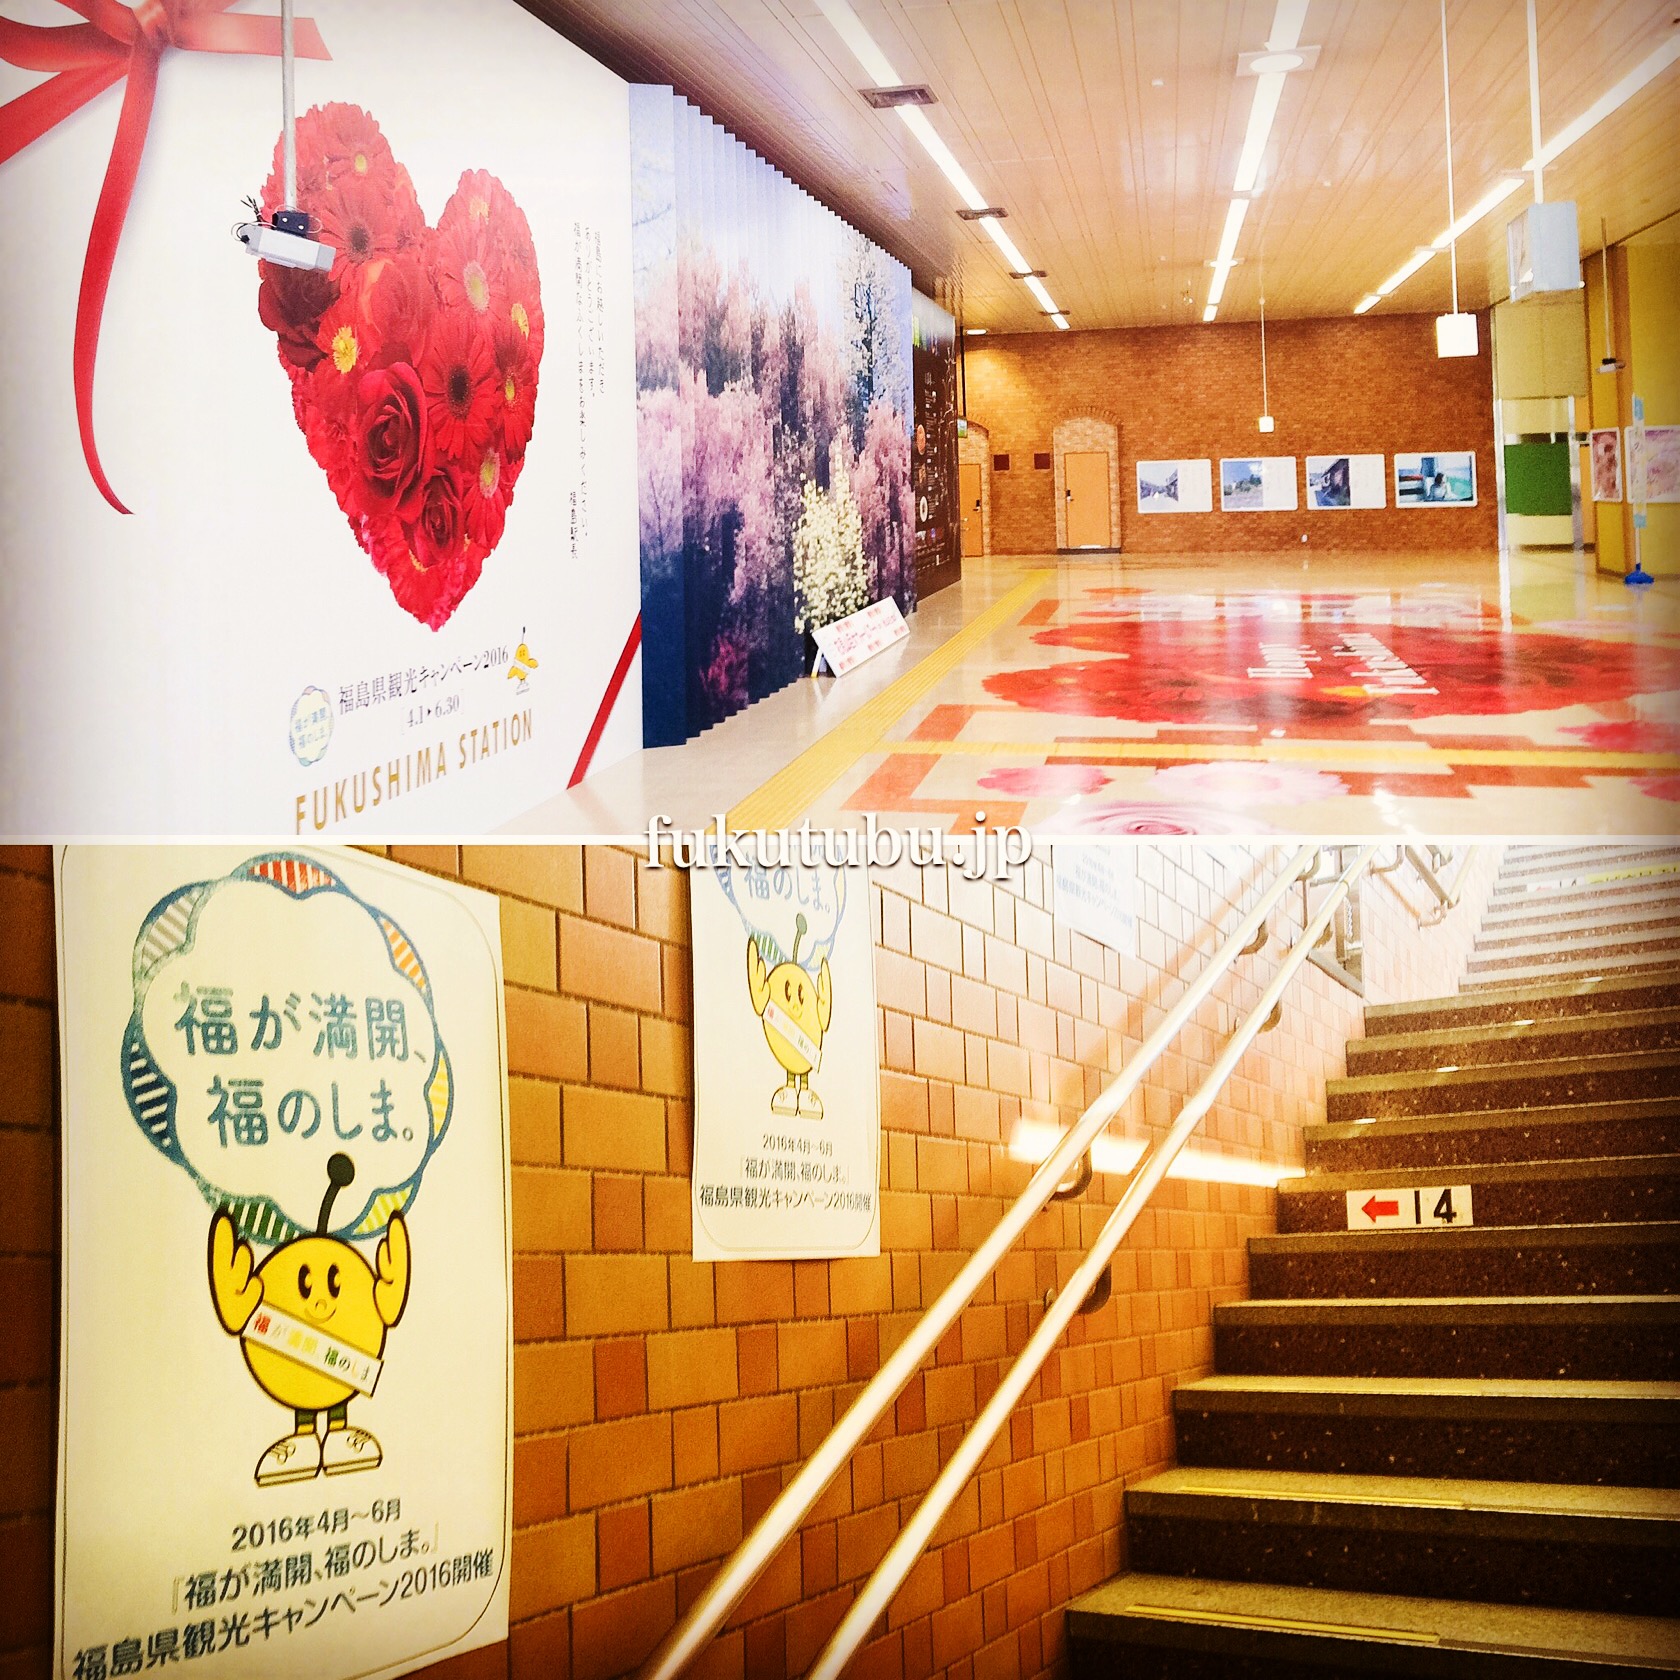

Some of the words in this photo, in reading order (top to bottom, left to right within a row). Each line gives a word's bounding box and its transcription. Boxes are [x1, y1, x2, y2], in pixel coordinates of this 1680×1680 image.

[338, 645, 509, 715] 福島県観光キャンペーン2016
[296, 742, 448, 835] FUKUSHIMA
[459, 708, 533, 769] STATION
[175, 982, 427, 1064] 福が満開、
[206, 1078, 414, 1149] 福のしま。
[699, 1183, 872, 1213] 福島県観光キャンペーン2016開催
[72, 1548, 494, 1680] 福島県観光キャンペーン2016開催
